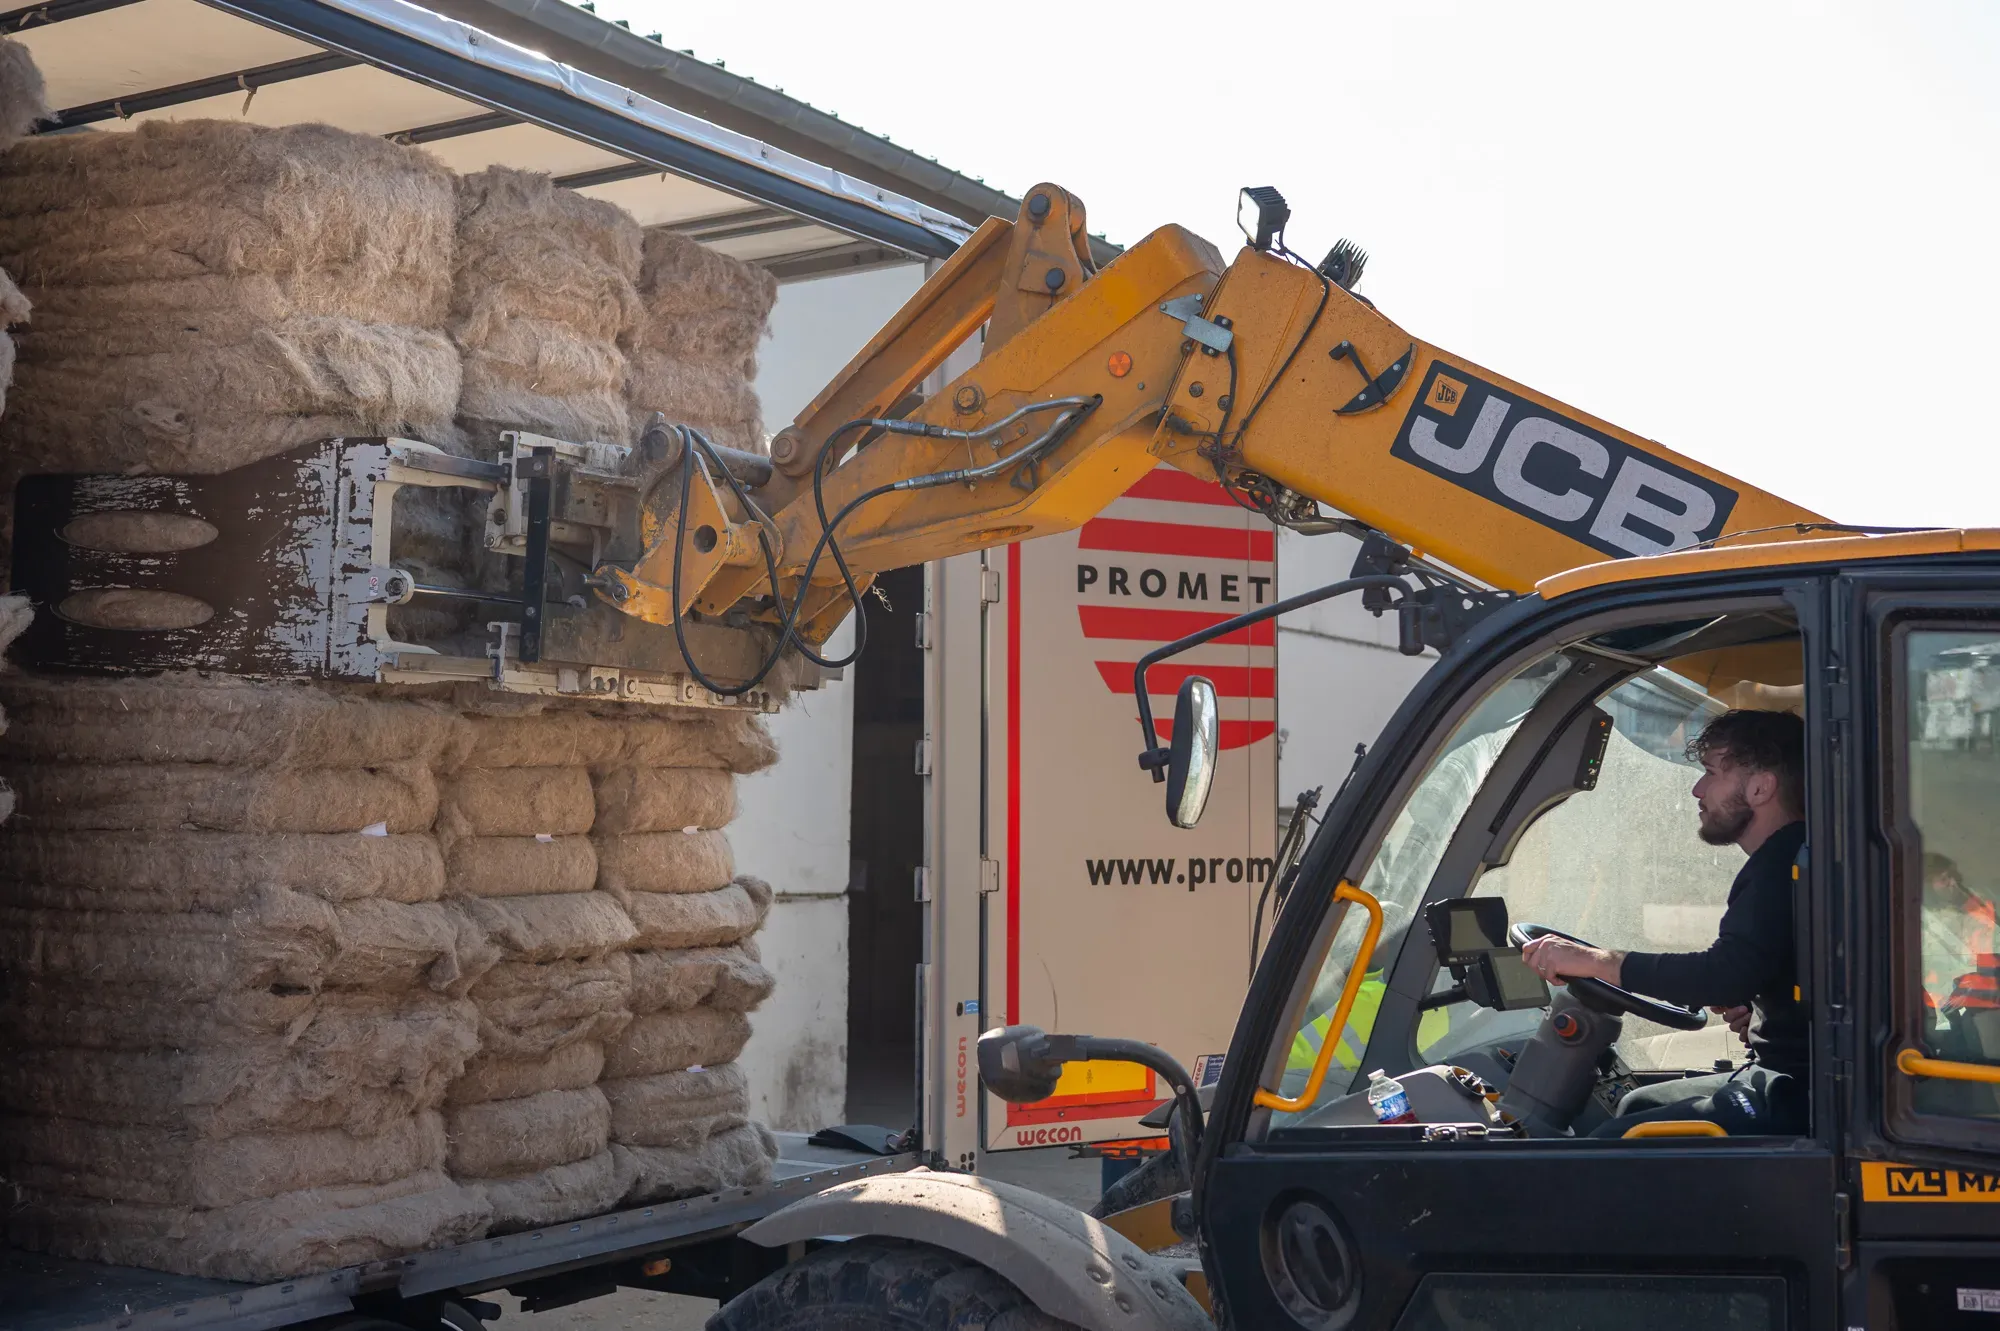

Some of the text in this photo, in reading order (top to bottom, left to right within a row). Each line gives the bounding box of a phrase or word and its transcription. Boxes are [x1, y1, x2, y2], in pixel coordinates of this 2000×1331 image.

[1437, 384, 1457, 402] JCB
[1409, 394, 1716, 557] JCB
[1077, 564, 1271, 603] PROMET
[1086, 855, 1274, 891] www.prom
[956, 1037, 967, 1117] wecon
[1017, 1126, 1082, 1146] wecon
